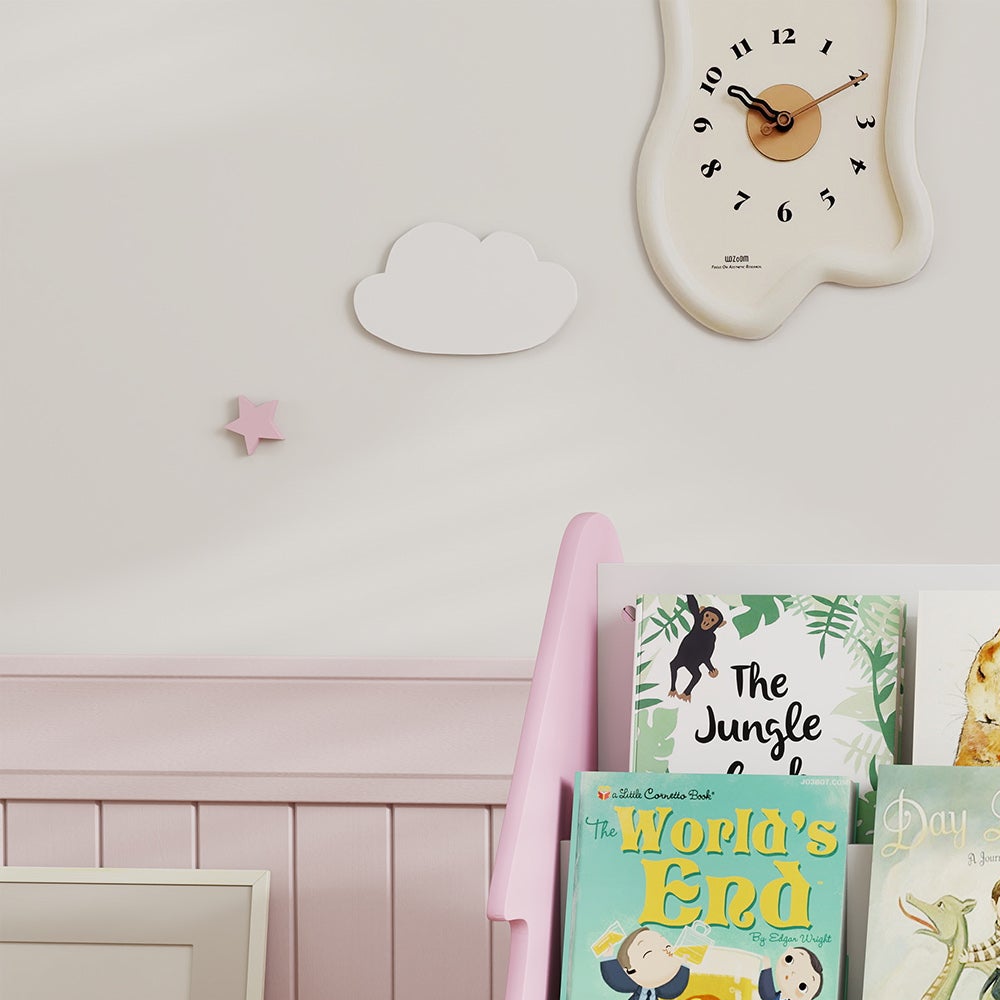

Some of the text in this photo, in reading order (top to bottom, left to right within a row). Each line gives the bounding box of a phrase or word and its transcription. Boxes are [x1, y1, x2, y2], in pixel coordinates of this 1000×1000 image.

[771, 28, 796, 45] 12
[819, 38, 833, 56] 1
[729, 38, 753, 61] 11
[699, 66, 723, 96] 10
[693, 117, 714, 134] 9
[855, 115, 876, 130] 3
[700, 158, 722, 179] 8
[849, 157, 867, 176] 4
[733, 190, 751, 211] 7
[819, 188, 836, 211] 5
[777, 200, 793, 223] 6
[730, 661, 789, 702] The
[694, 701, 823, 762] Jungle
[619, 788, 641, 799] Little
[643, 787, 687, 800] Cornetto
[585, 805, 838, 858] The World's
[880, 788, 968, 858] Day
[967, 852, 977, 866] A
[638, 857, 813, 931] End
[749, 931, 832, 948] By Edgar Wright
